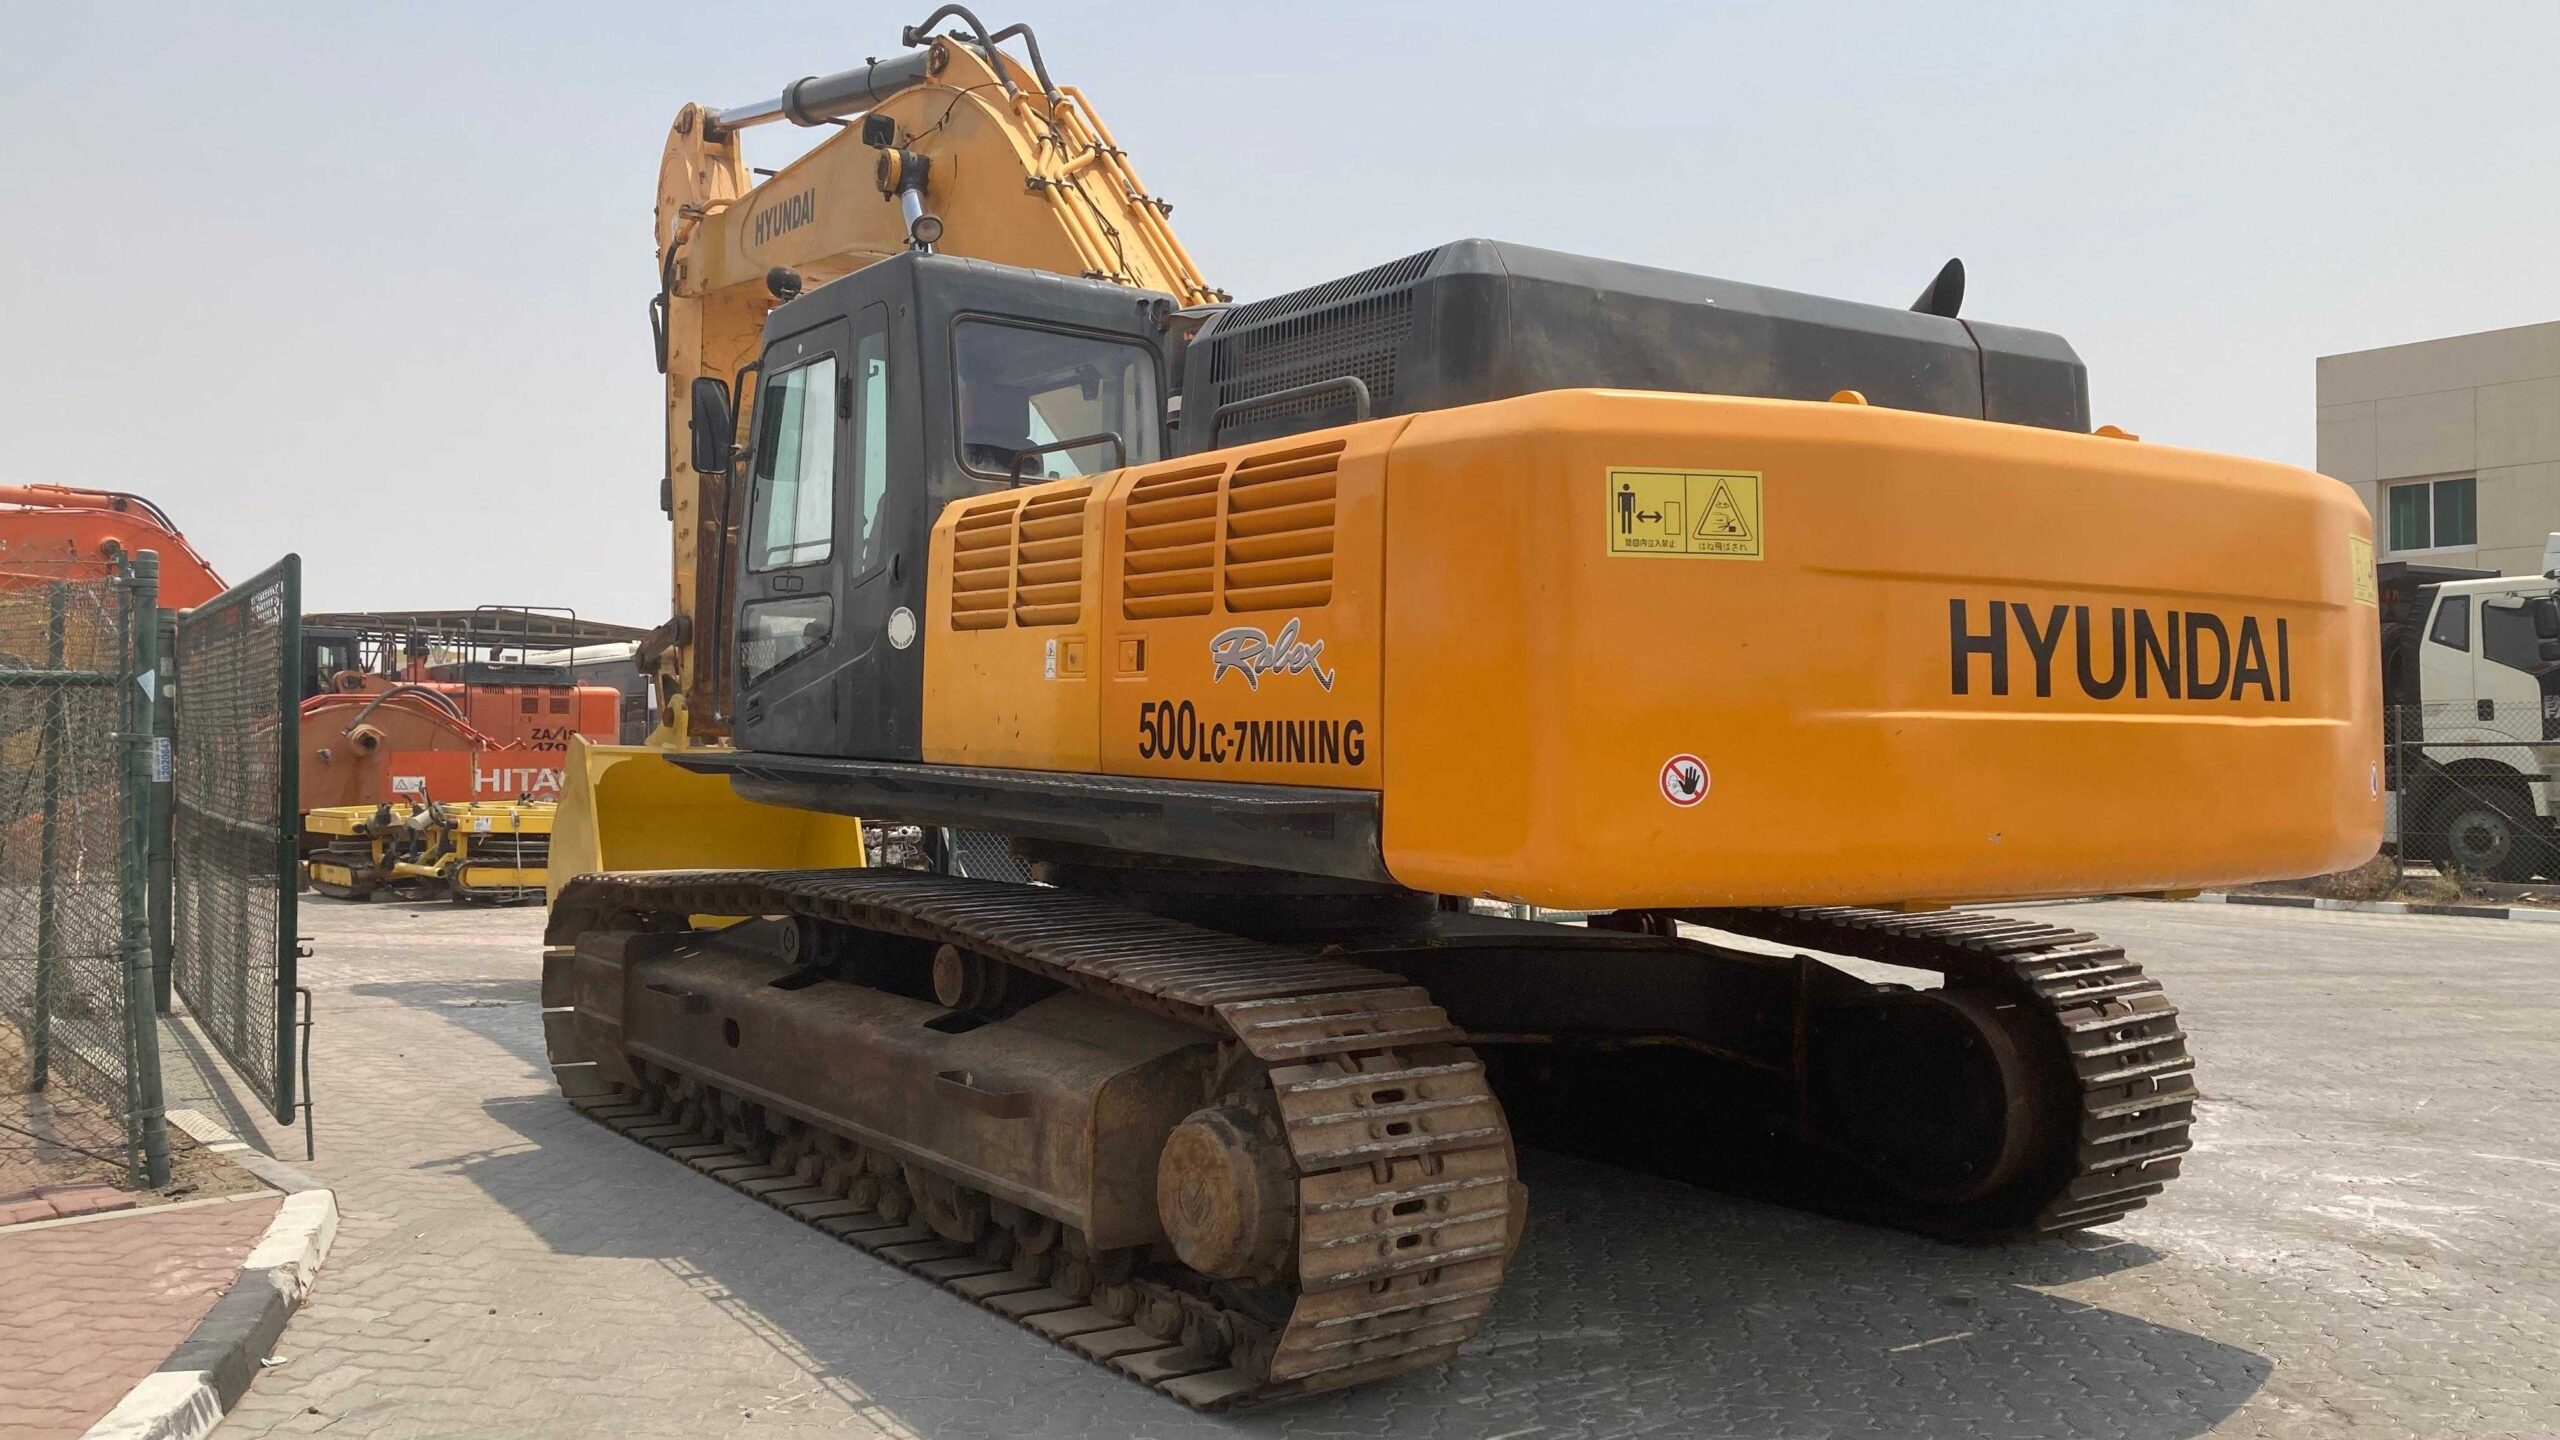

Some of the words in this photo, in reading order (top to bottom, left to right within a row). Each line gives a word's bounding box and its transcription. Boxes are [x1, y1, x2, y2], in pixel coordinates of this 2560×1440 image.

[755, 187, 815, 248] HYUNDAI
[1210, 617, 1335, 692] Robex
[1950, 598, 2290, 702] HYUNDAI
[474, 768, 567, 792] HITA
